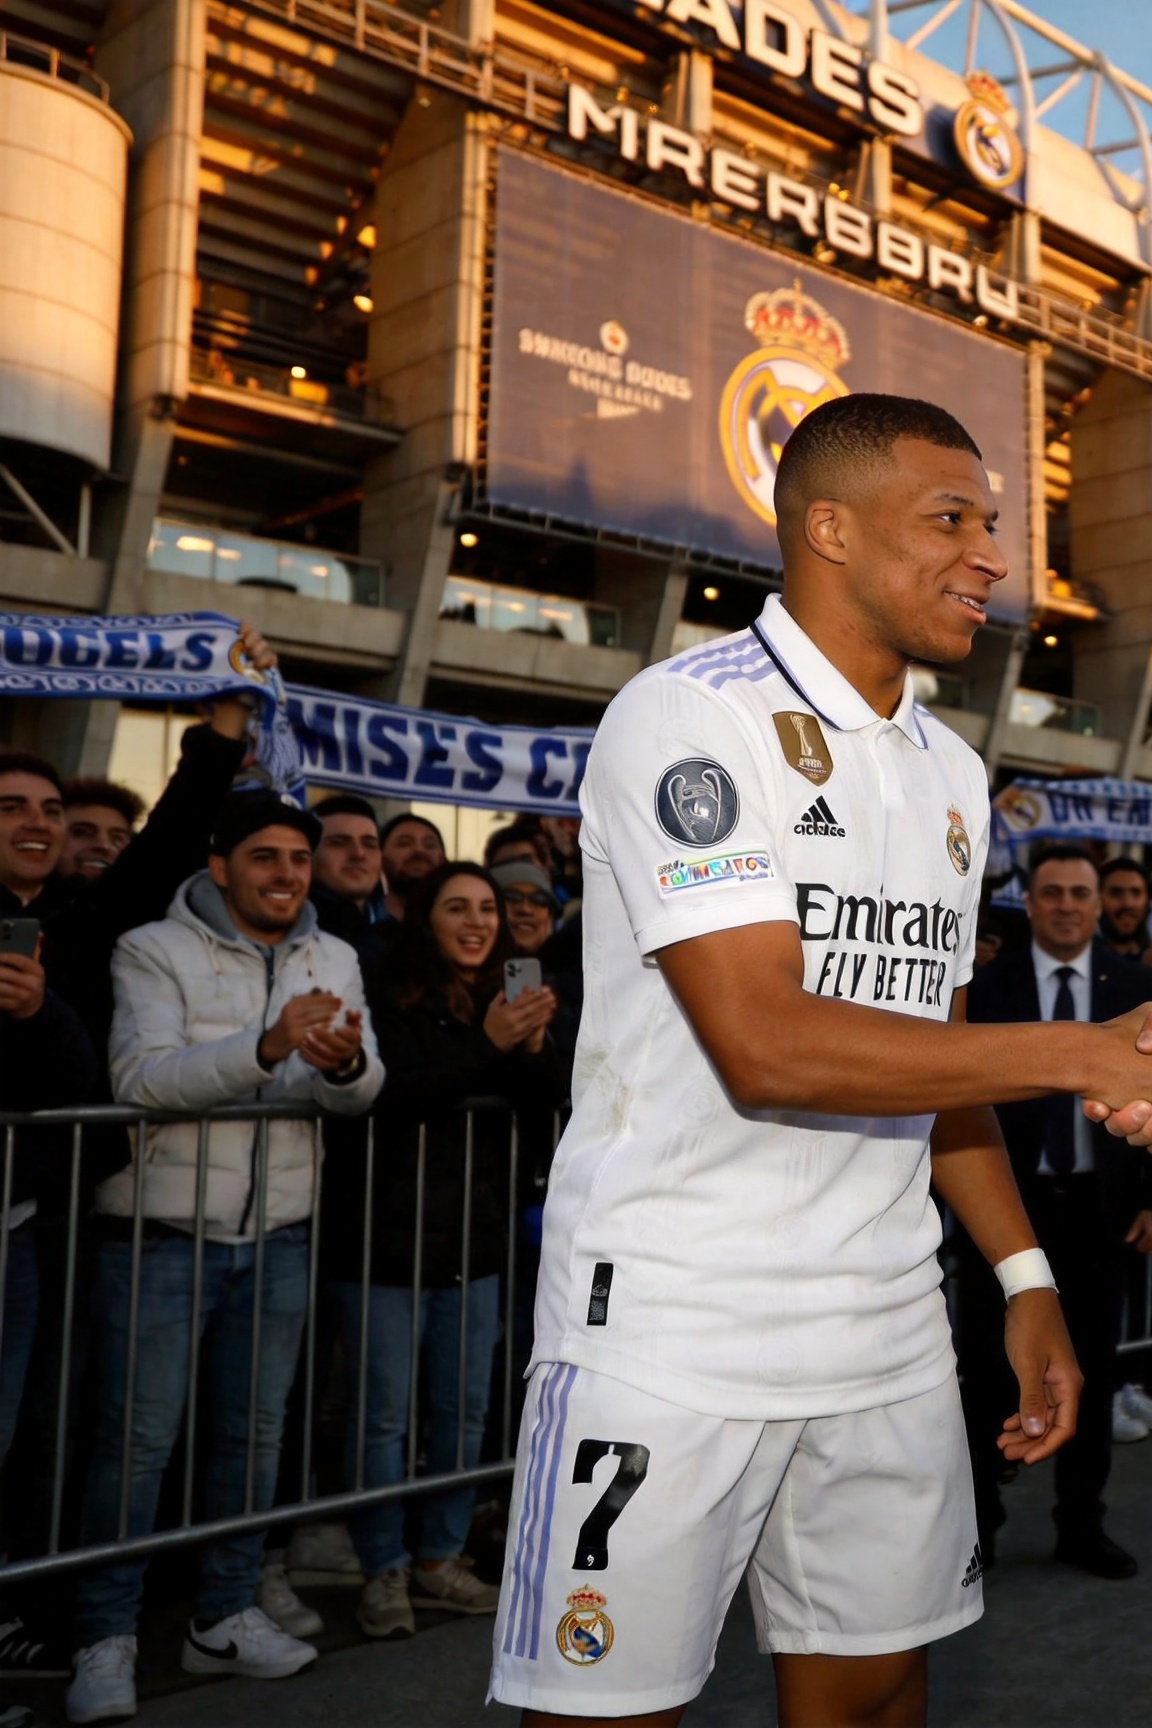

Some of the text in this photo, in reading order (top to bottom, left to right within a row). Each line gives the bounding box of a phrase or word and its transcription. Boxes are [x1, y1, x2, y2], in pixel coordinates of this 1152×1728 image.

[633, 0, 922, 136] ADES
[816, 952, 946, 1006] FLY BETTER
[571, 1438, 651, 1571] 7
